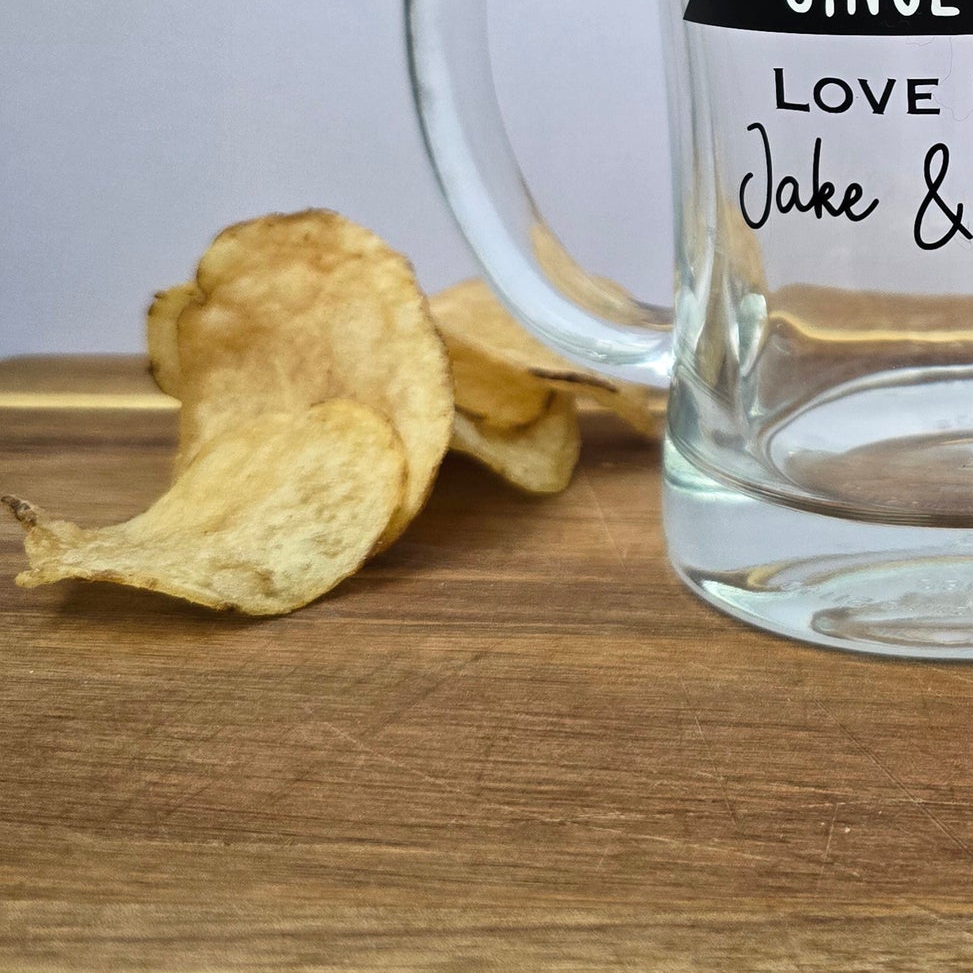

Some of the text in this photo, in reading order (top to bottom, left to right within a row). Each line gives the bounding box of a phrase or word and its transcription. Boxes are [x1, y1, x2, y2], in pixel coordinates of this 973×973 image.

[773, 67, 941, 115] LOVE
[739, 122, 880, 230] Jake
[913, 142, 973, 251] &
